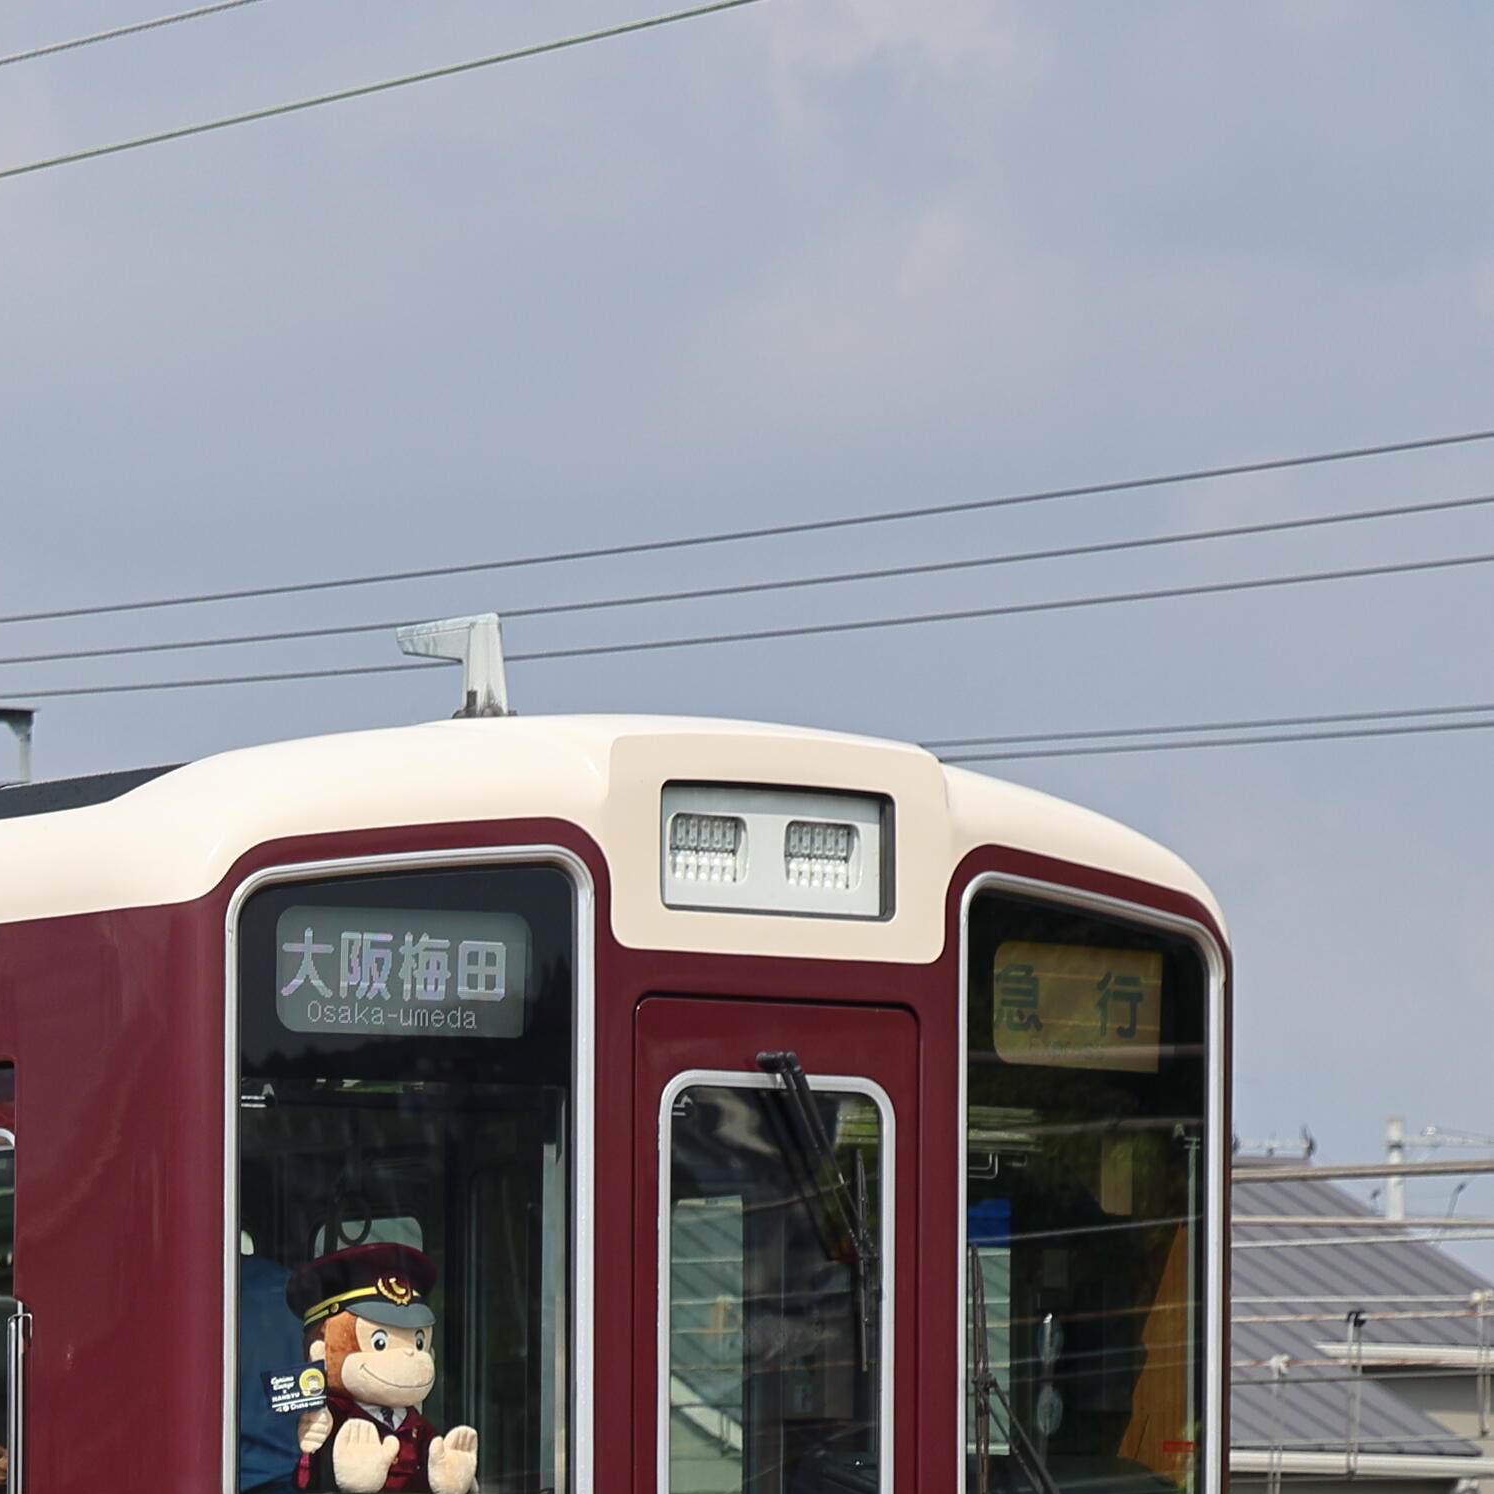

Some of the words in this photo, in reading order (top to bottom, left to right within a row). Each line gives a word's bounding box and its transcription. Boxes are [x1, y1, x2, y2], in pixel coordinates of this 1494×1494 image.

[281, 927, 507, 1002] 大阪梅田
[994, 963, 1144, 1039] 急行
[307, 1000, 478, 1030] Osaka-umeda
